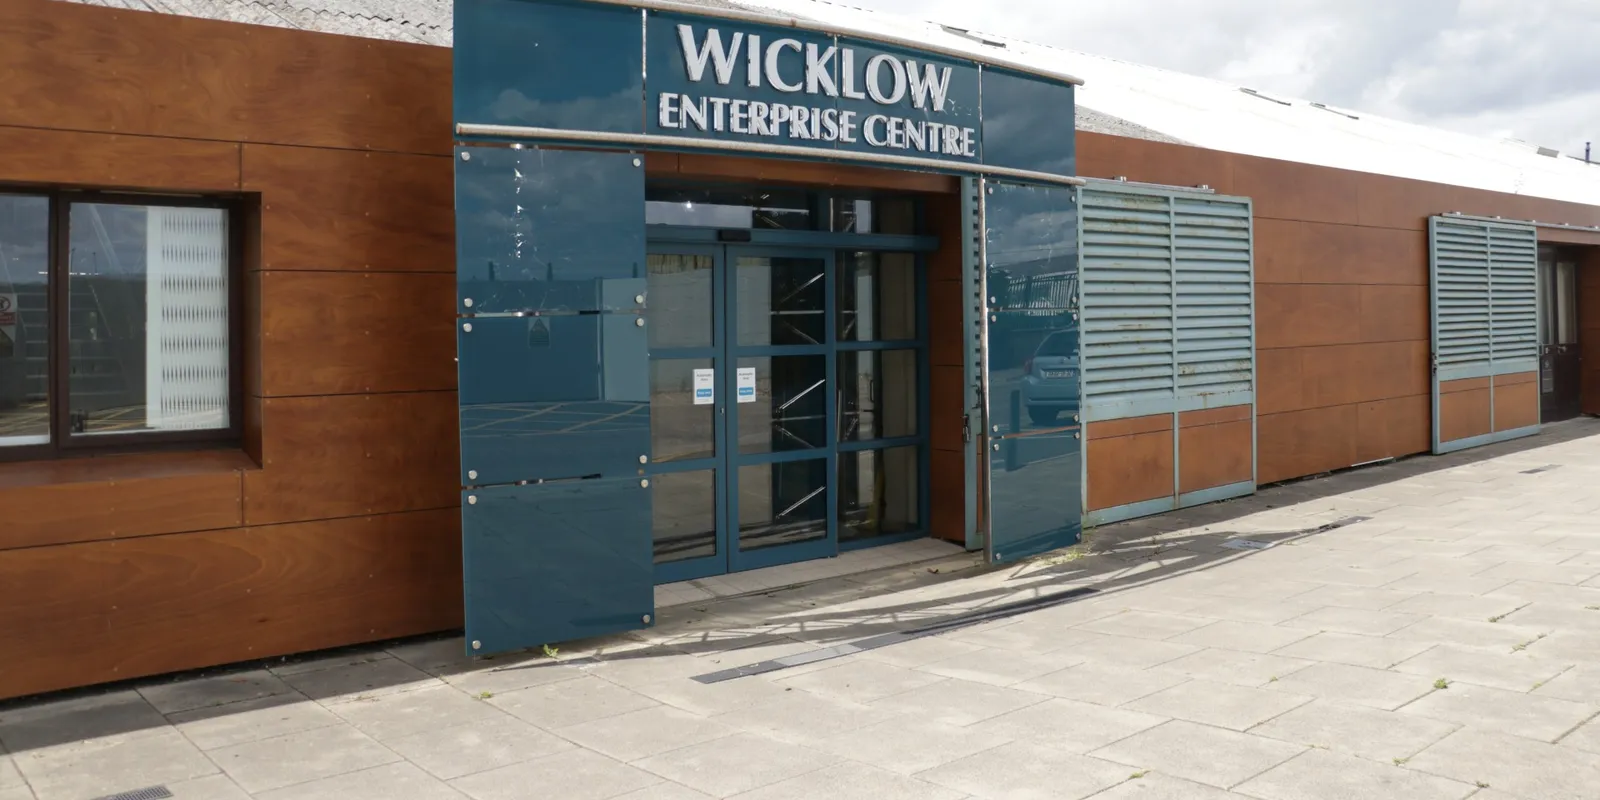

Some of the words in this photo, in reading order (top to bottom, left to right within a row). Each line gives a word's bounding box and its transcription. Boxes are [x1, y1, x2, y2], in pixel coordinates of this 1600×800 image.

[677, 24, 952, 111] WICKLOW
[659, 92, 857, 142] ENTERPRISE
[863, 114, 976, 157] CENTRE
